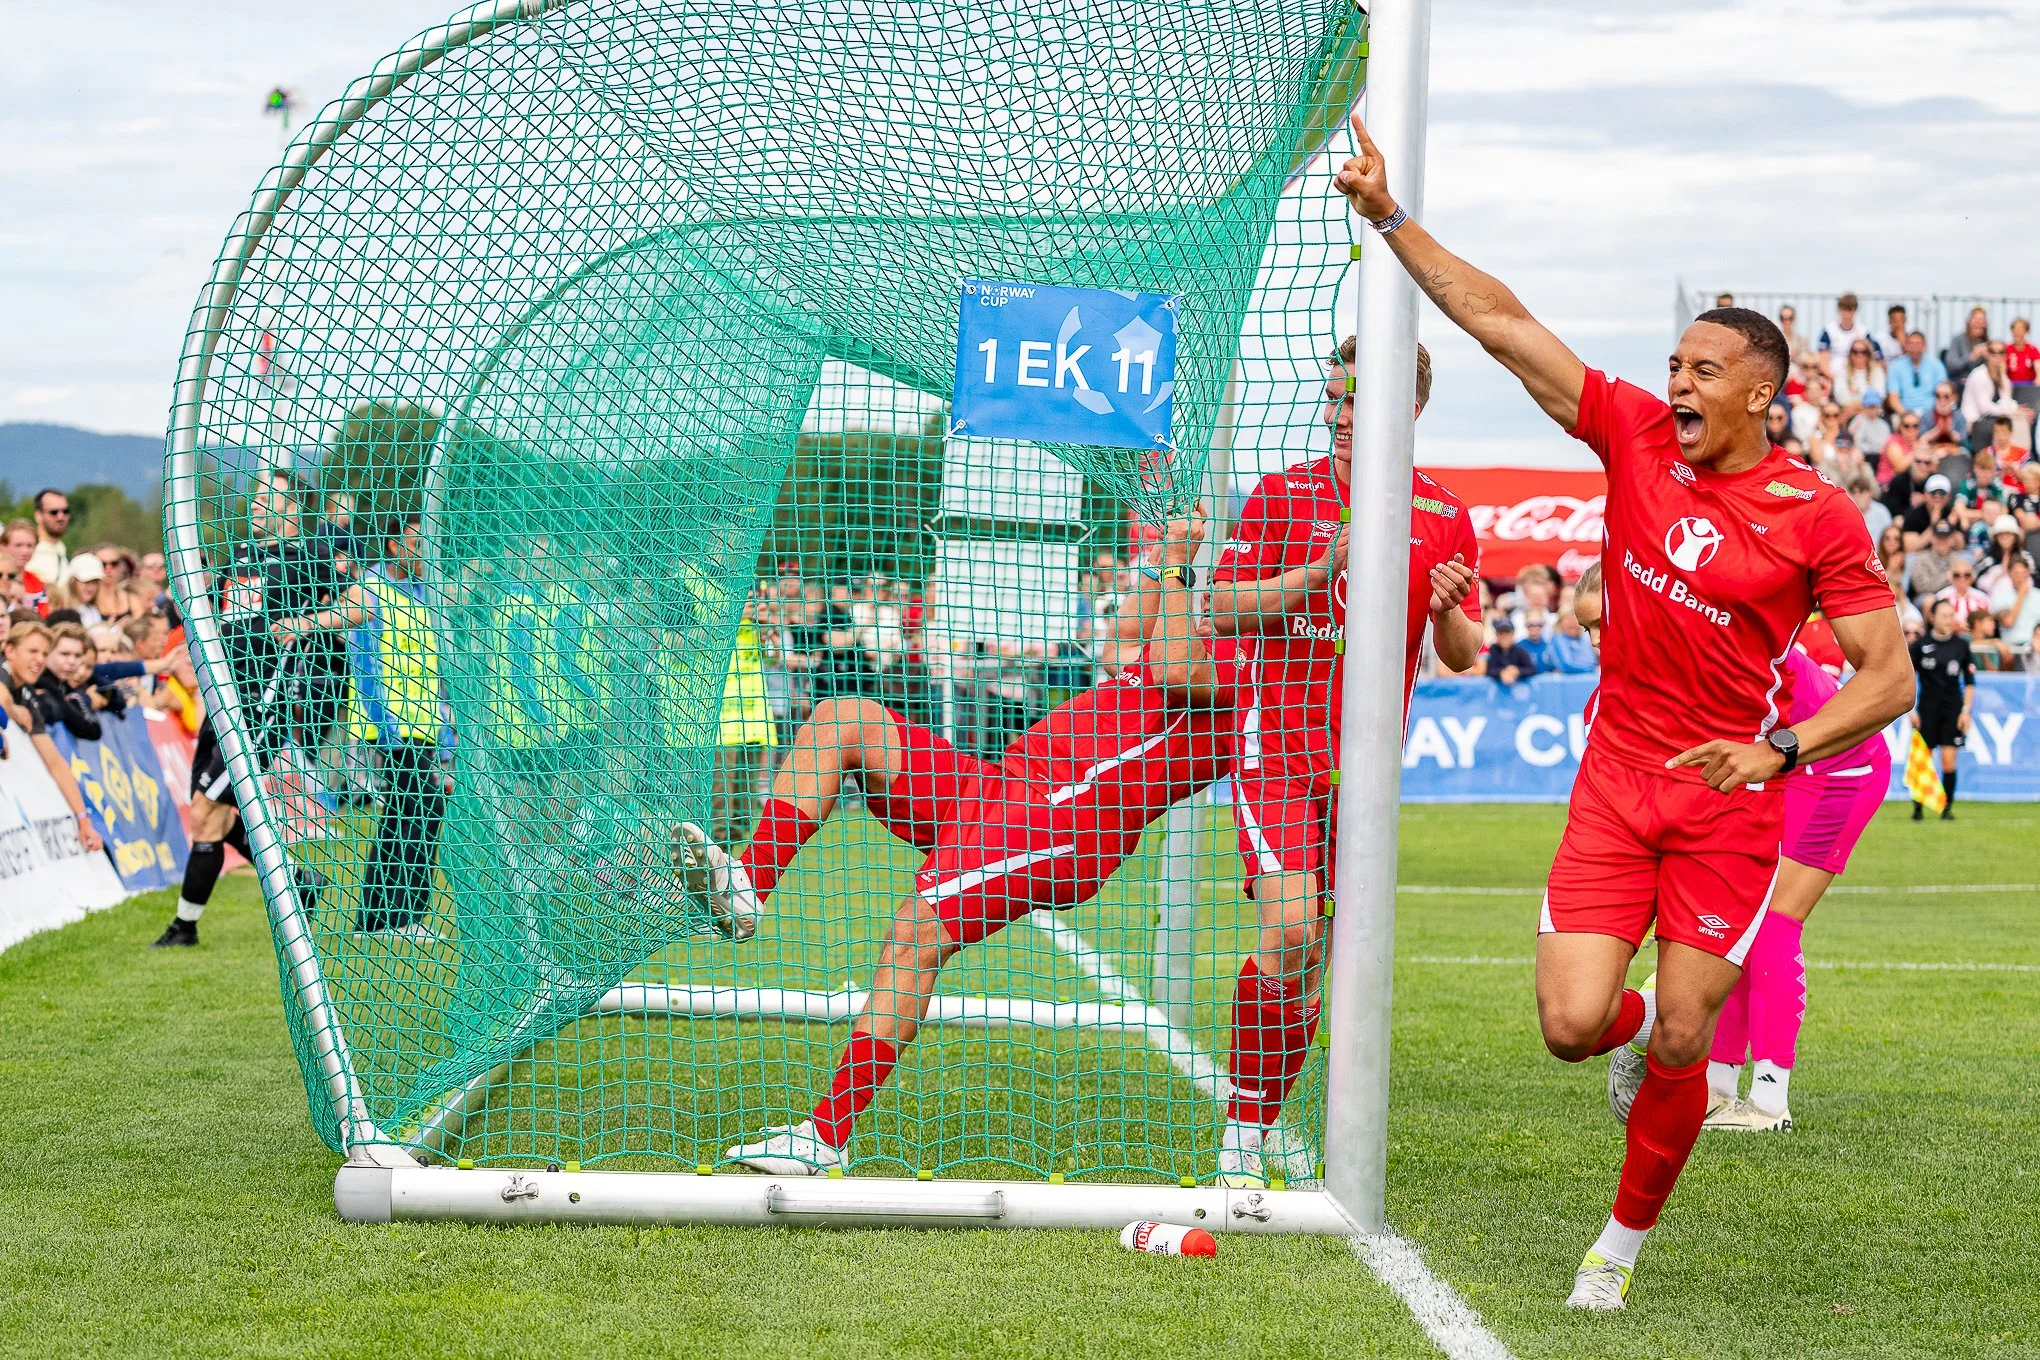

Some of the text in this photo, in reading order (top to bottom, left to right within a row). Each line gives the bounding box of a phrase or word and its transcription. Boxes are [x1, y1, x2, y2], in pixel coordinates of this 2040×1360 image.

[980, 296, 1009, 307] CUP
[978, 338, 1154, 395] 1 EK 11
[1311, 530, 1333, 539] umbr
[1624, 548, 1669, 594] Redd
[1668, 579, 1732, 627] Barna
[1402, 715, 1489, 769] AY
[1698, 925, 1726, 940] umbro
